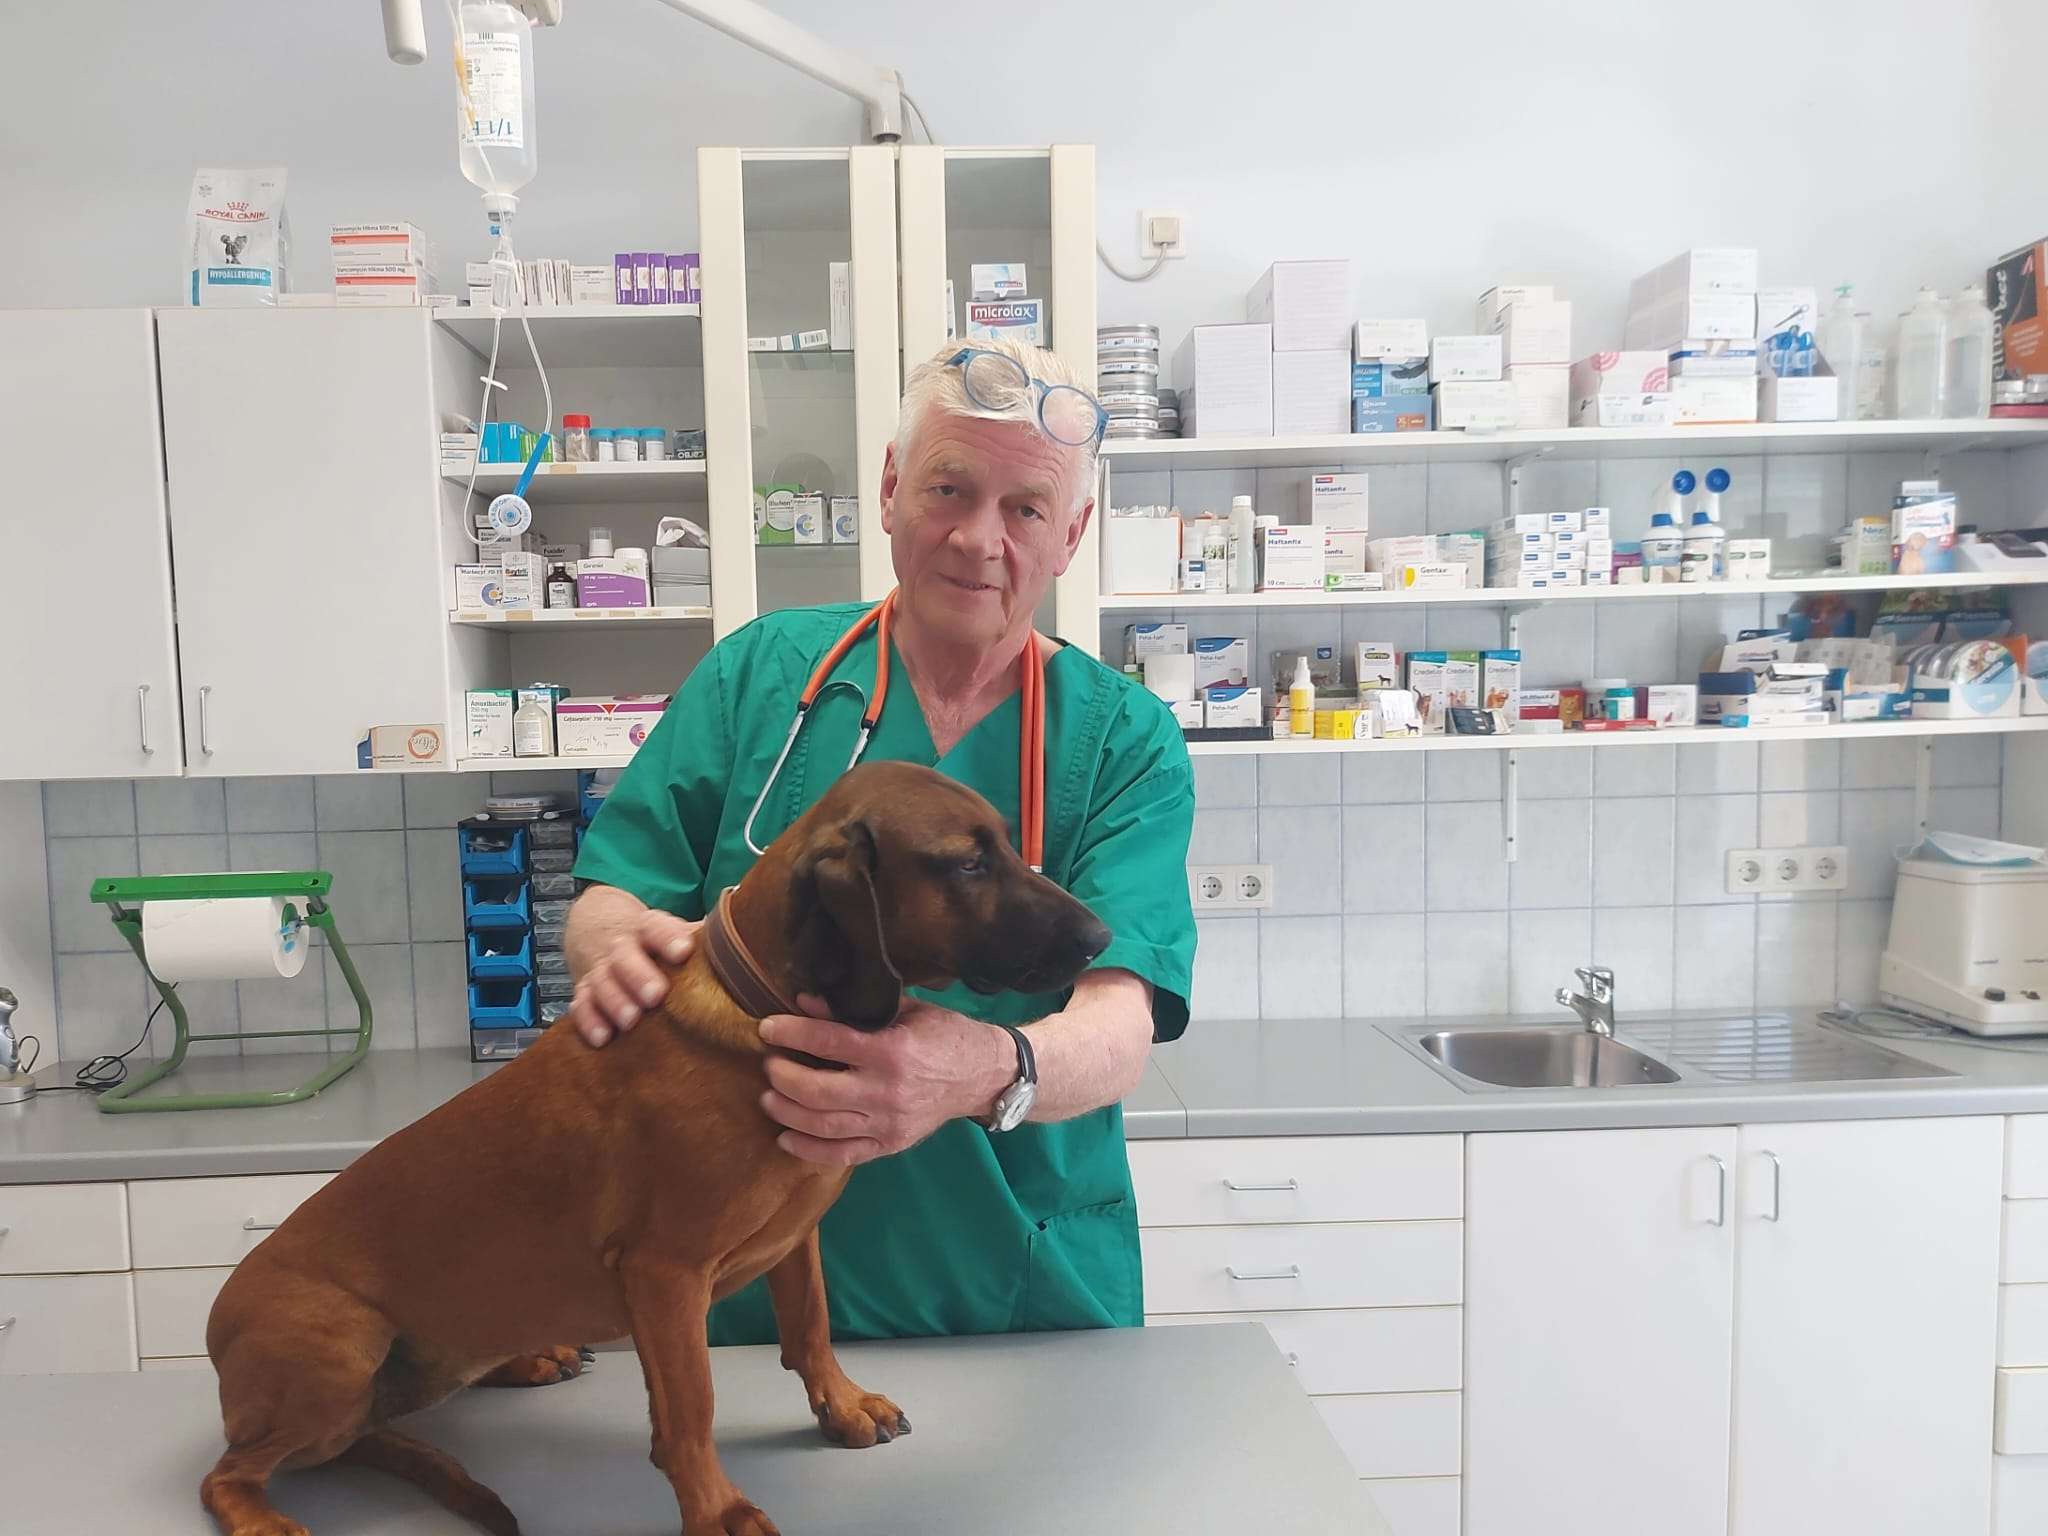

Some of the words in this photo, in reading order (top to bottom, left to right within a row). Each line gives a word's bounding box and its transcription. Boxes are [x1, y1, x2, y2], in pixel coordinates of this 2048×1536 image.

[205, 208, 234, 219] ROYAL
[237, 211, 265, 220] CANIN
[209, 270, 266, 279] HYPOALLERGENIC
[975, 306, 1032, 318] microlax
